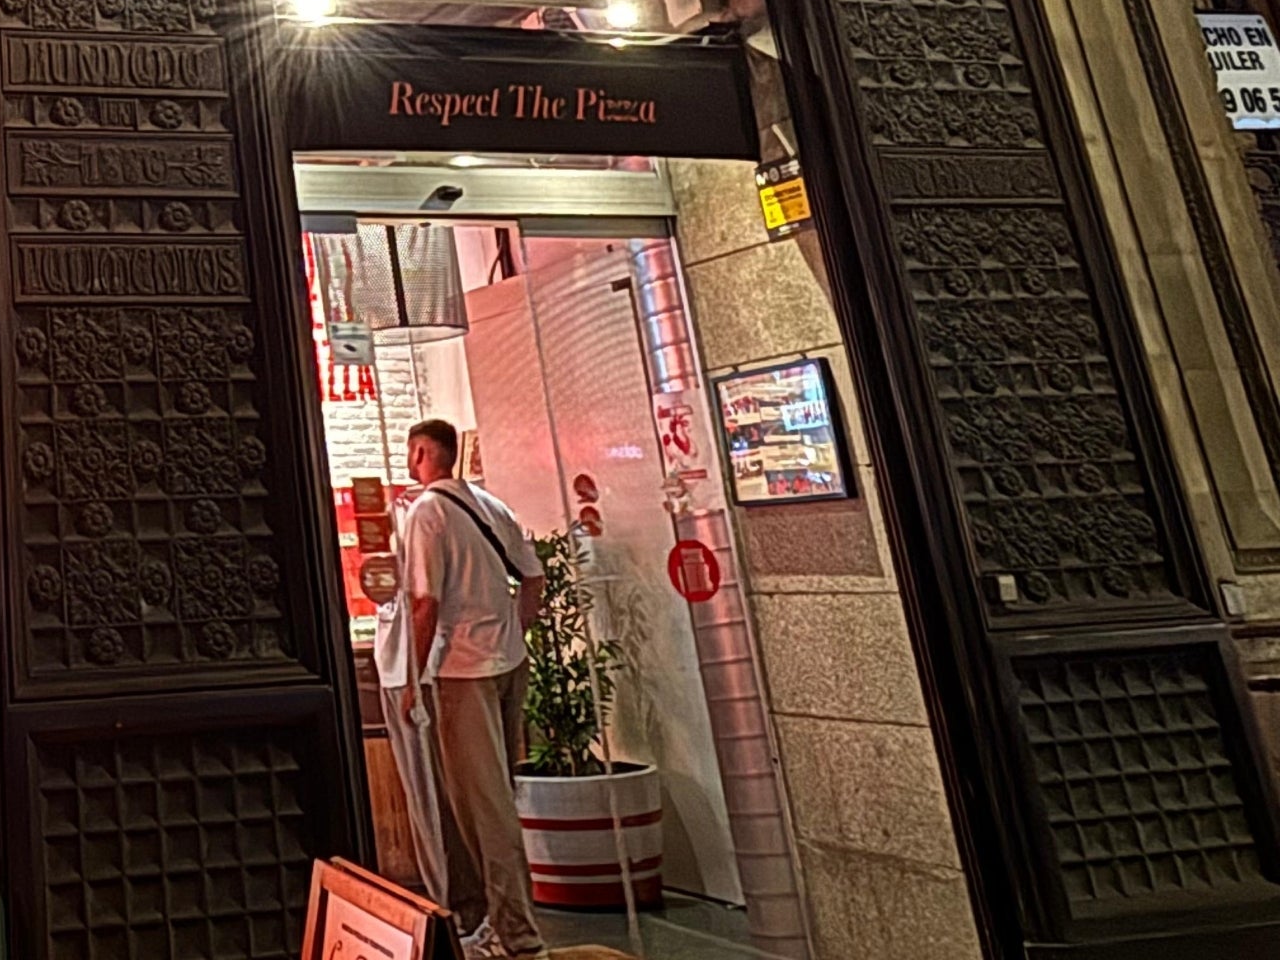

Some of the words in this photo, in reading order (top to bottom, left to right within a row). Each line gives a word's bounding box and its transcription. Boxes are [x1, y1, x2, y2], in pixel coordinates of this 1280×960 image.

[1243, 27, 1273, 47] EN
[389, 81, 500, 126] Respect
[508, 85, 566, 119] The
[575, 87, 657, 124] Pizza
